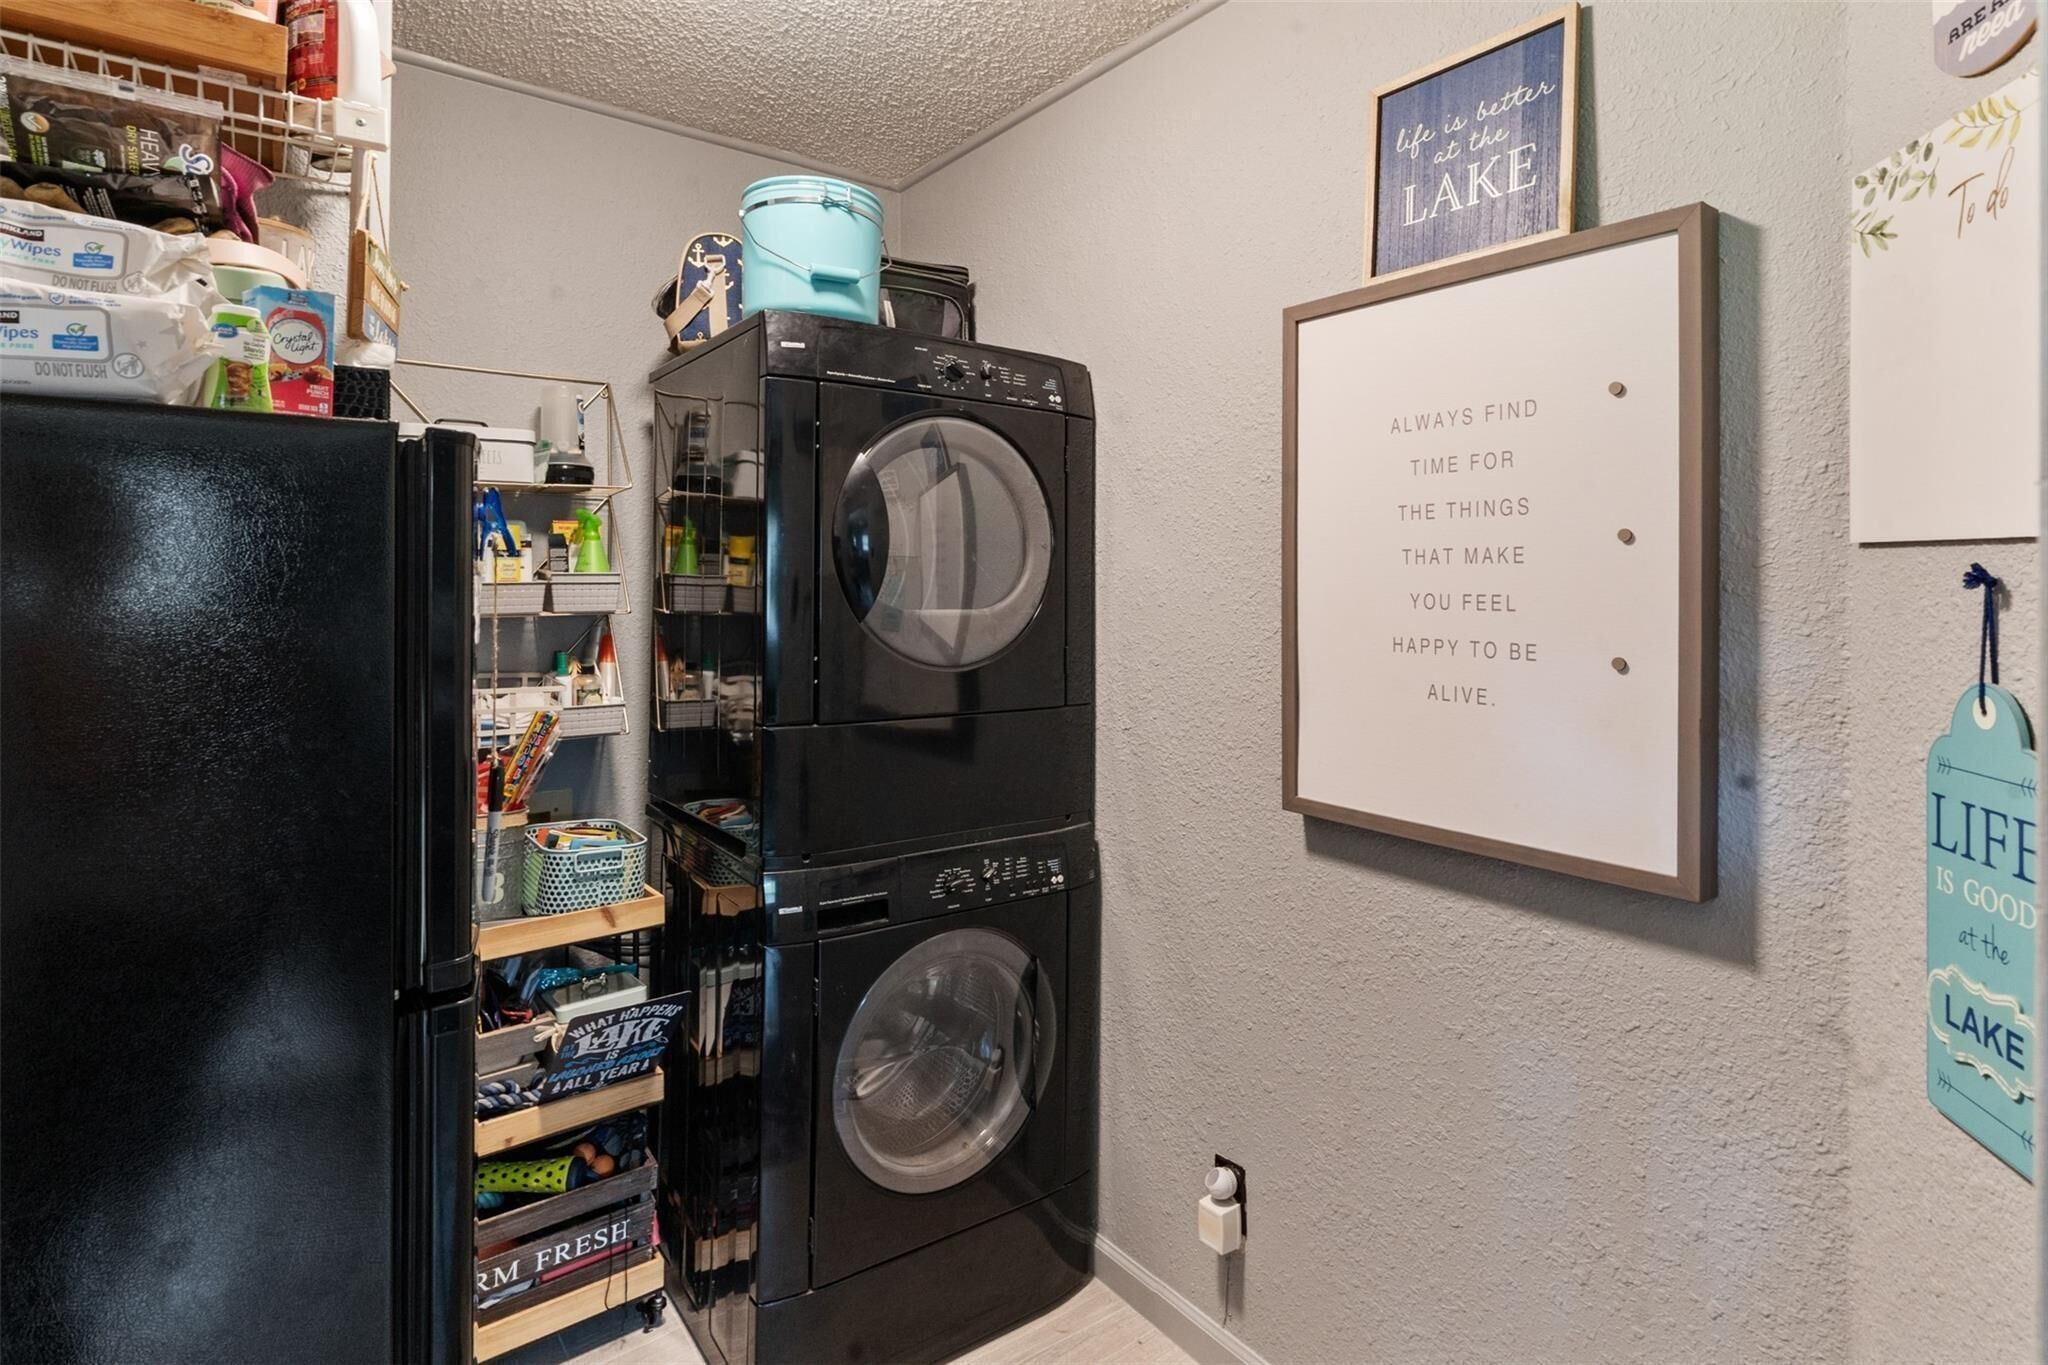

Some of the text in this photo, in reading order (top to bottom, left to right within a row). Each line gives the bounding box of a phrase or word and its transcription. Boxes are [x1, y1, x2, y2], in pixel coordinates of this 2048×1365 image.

[1947, 6, 1986, 45] ARE
[126, 124, 138, 146] DRY
[1396, 81, 1556, 159] life is better
[1434, 126, 1509, 164] at the
[1403, 143, 1536, 226] LAKE
[1948, 146, 2015, 239] To do
[52, 274, 117, 294] DO NOT FLUSH
[273, 332, 313, 350] Crystal
[34, 362, 108, 379] DO NOT FLUSH
[1390, 399, 1537, 434] ALWAYS FIND
[1410, 450, 1514, 476] TIME FOR
[1398, 497, 1529, 521] THE THINGS
[1402, 546, 1525, 565] THAT MAKE
[1410, 593, 1516, 612] YOU FEEL
[1393, 637, 1537, 662] HAPPY TO BE
[1427, 684, 1495, 707] ALIVE.
[1931, 792, 2037, 884] LIFE
[1935, 866, 2038, 929] IS GOOD
[1958, 924, 2010, 966] at the
[568, 1003, 683, 1039] WHAT HAPPENS
[573, 1016, 670, 1060] LAKE
[1945, 993, 2025, 1071] LAKE
[605, 1050, 619, 1060] IS
[562, 1061, 640, 1091] ALL YEAR
[534, 1218, 631, 1273] FRESH
